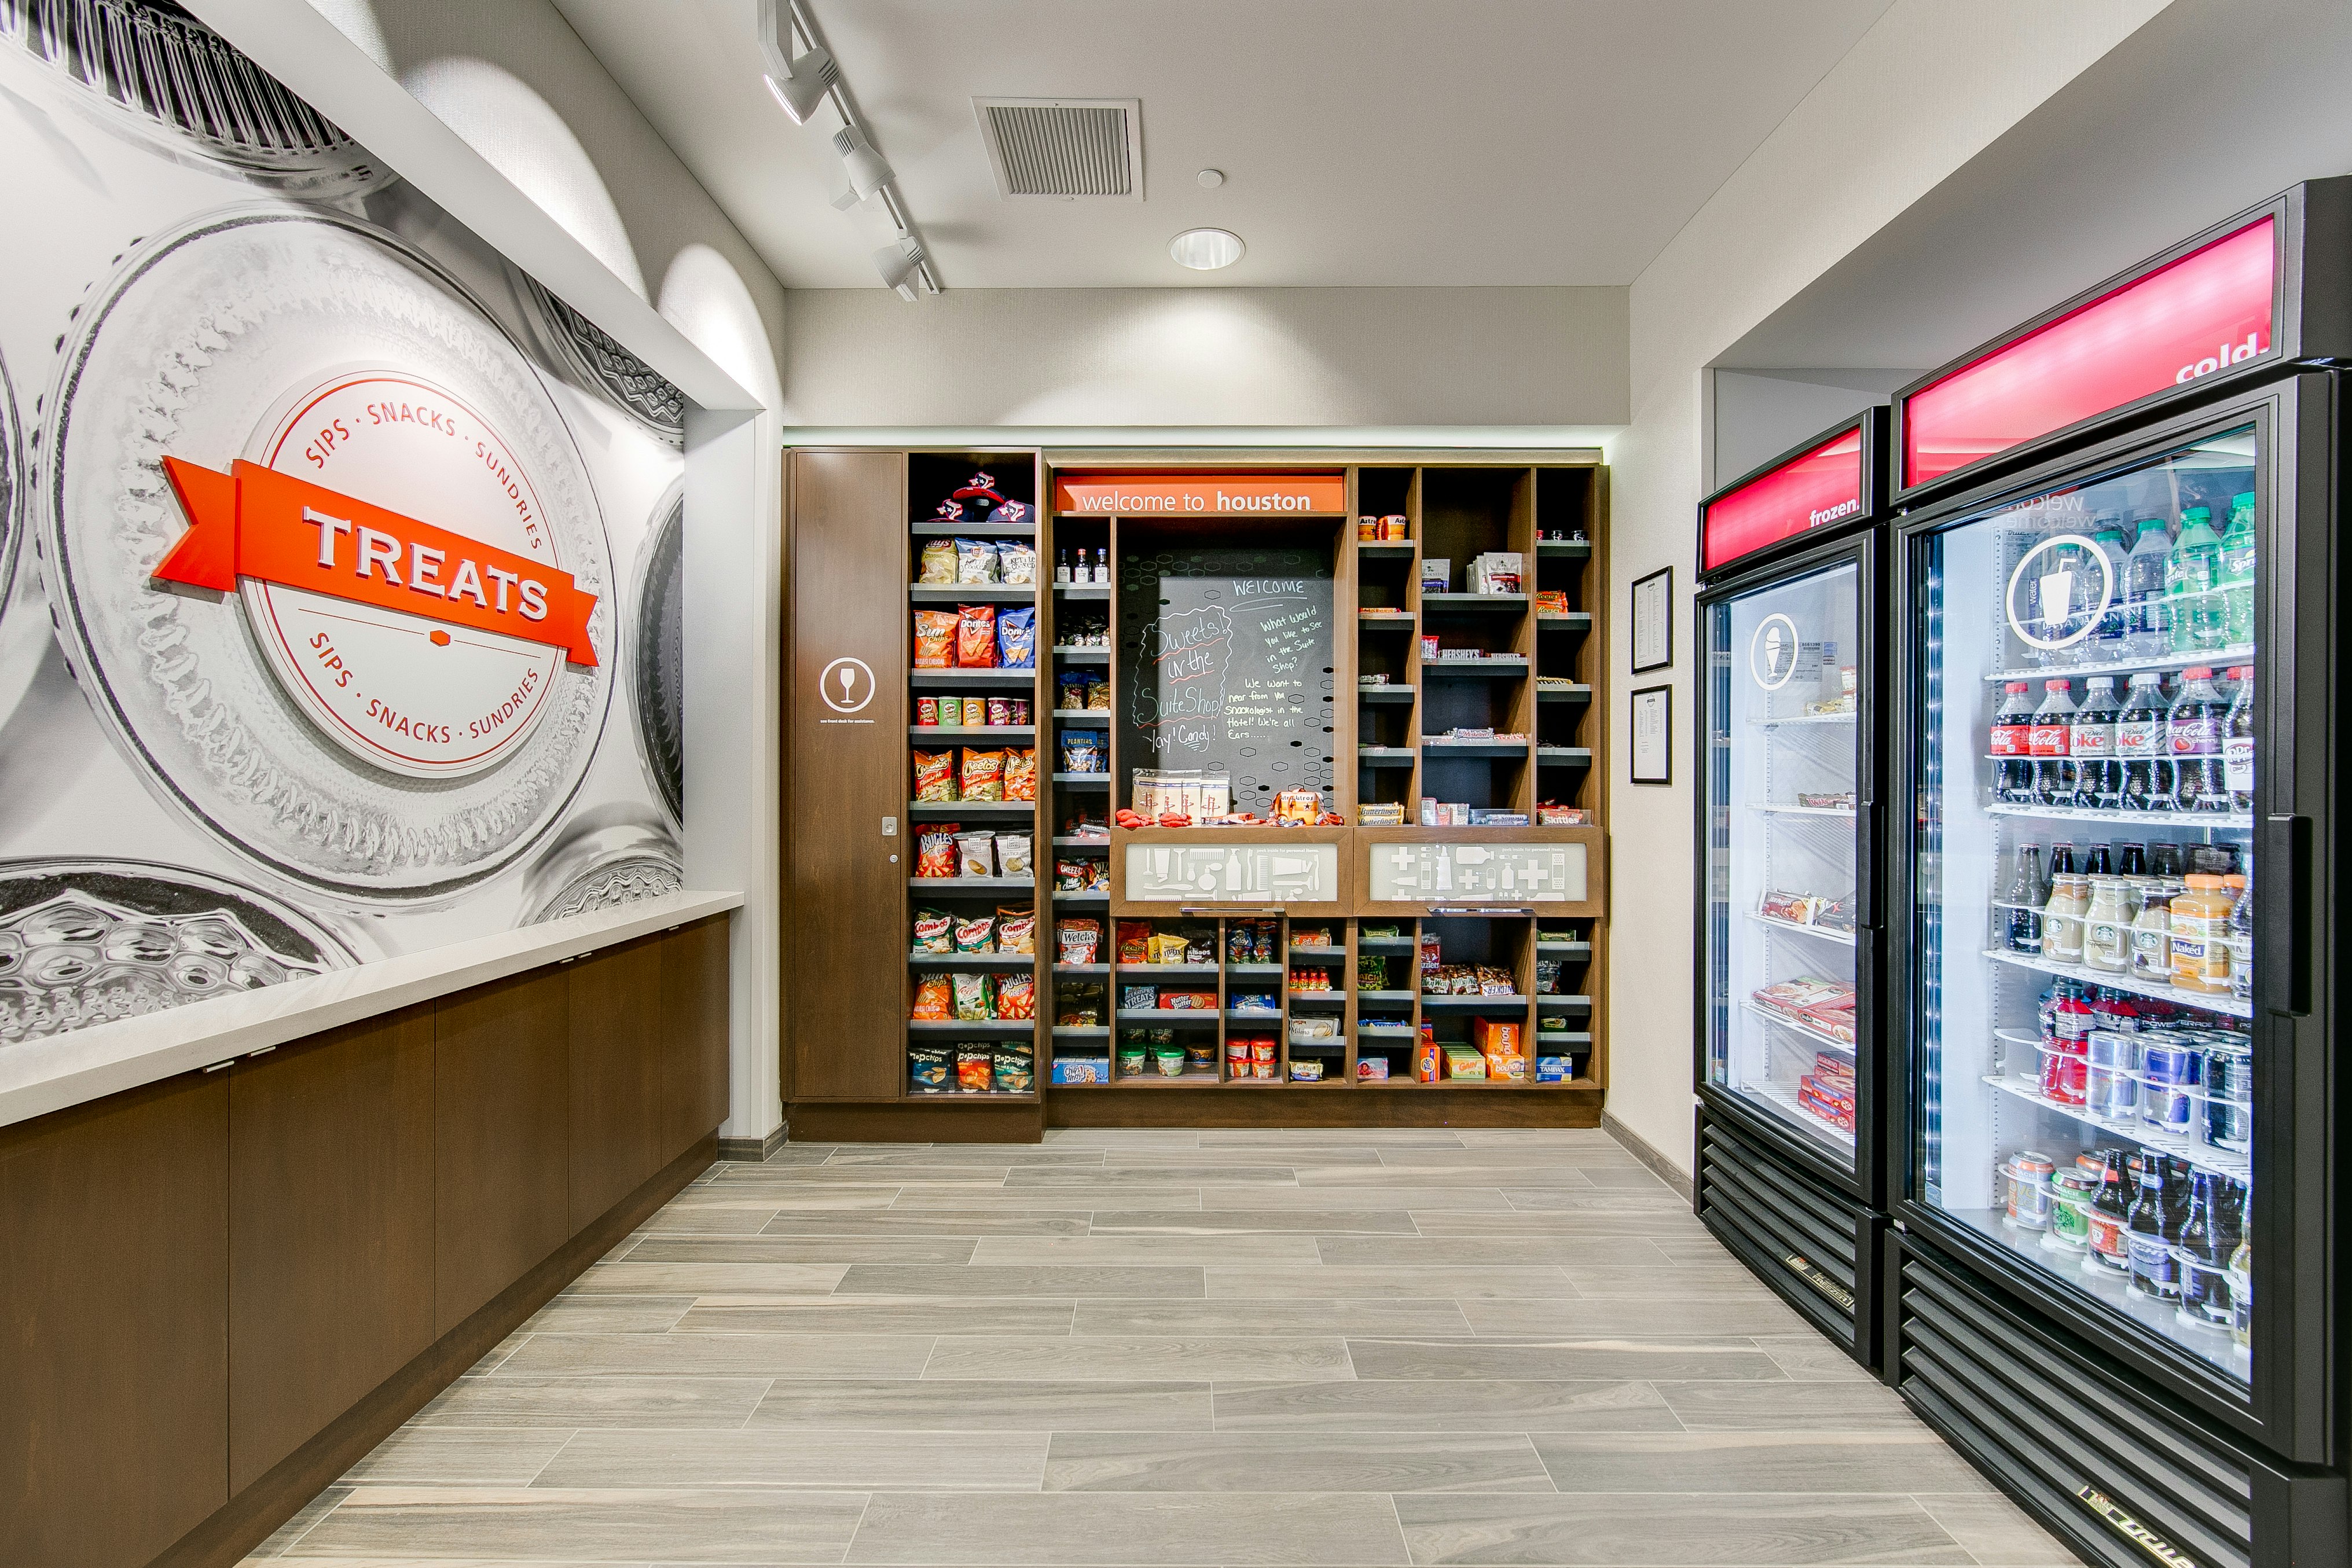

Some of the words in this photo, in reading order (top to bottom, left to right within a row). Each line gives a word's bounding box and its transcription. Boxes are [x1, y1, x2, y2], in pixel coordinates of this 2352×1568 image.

[2175, 332, 2270, 384] cold.
[305, 418, 350, 469] SIPS
[366, 402, 456, 436] SNACKS
[476, 441, 543, 550] SUNDRIES
[1082, 491, 1176, 511] welcome
[1183, 493, 1205, 511] to
[1217, 490, 1311, 511] houston
[1809, 498, 1860, 527] frozen.
[302, 505, 549, 622] TREATS
[2231, 557, 2255, 574] Spri
[916, 623, 946, 637] Sun
[960, 619, 991, 629] Doritos
[1260, 616, 1286, 632] What
[927, 635, 949, 644] Chips
[1282, 630, 1298, 640] like
[1301, 626, 1310, 634] to
[1265, 654, 1277, 663] in
[1278, 646, 1294, 656] the
[1442, 649, 1480, 661] HERSHEY'S
[1491, 653, 1521, 662] HERSHEY'S
[1187, 649, 1214, 674] the
[310, 631, 354, 689] SIPS
[366, 699, 451, 744] SNACKS
[468, 666, 540, 741] SUNDRIES
[1245, 678, 1261, 688] We
[1248, 690, 1269, 700] from
[1289, 706, 1304, 714] the
[1257, 717, 1279, 727] We're
[1283, 718, 1295, 728] all
[2070, 733, 2104, 747] oke
[2116, 733, 2145, 747] oke
[963, 759, 999, 779] Cheetos
[1360, 806, 1400, 816] Butterfinger
[1360, 817, 1399, 826] Butterfinger
[1543, 815, 1580, 825] Skittles
[920, 833, 953, 854] BUGLES
[915, 918, 949, 934] Combos
[957, 920, 990, 939] Combos
[1063, 931, 1096, 943] Welch's
[2172, 942, 2202, 956] Naked
[926, 980, 947, 989] Chips
[1421, 978, 1435, 988] ilky
[1126, 993, 1155, 1009] TREATS
[1170, 994, 1190, 1004] Nutter
[1173, 1000, 1192, 1009] Butter
[1291, 1027, 1310, 1035] Milano
[957, 1052, 990, 1063] popchips
[994, 1054, 1026, 1066] popchips
[1065, 1067, 1080, 1076] Chips
[1495, 1063, 1520, 1073] bounce
[1812, 1275, 1848, 1302] FREEZER
